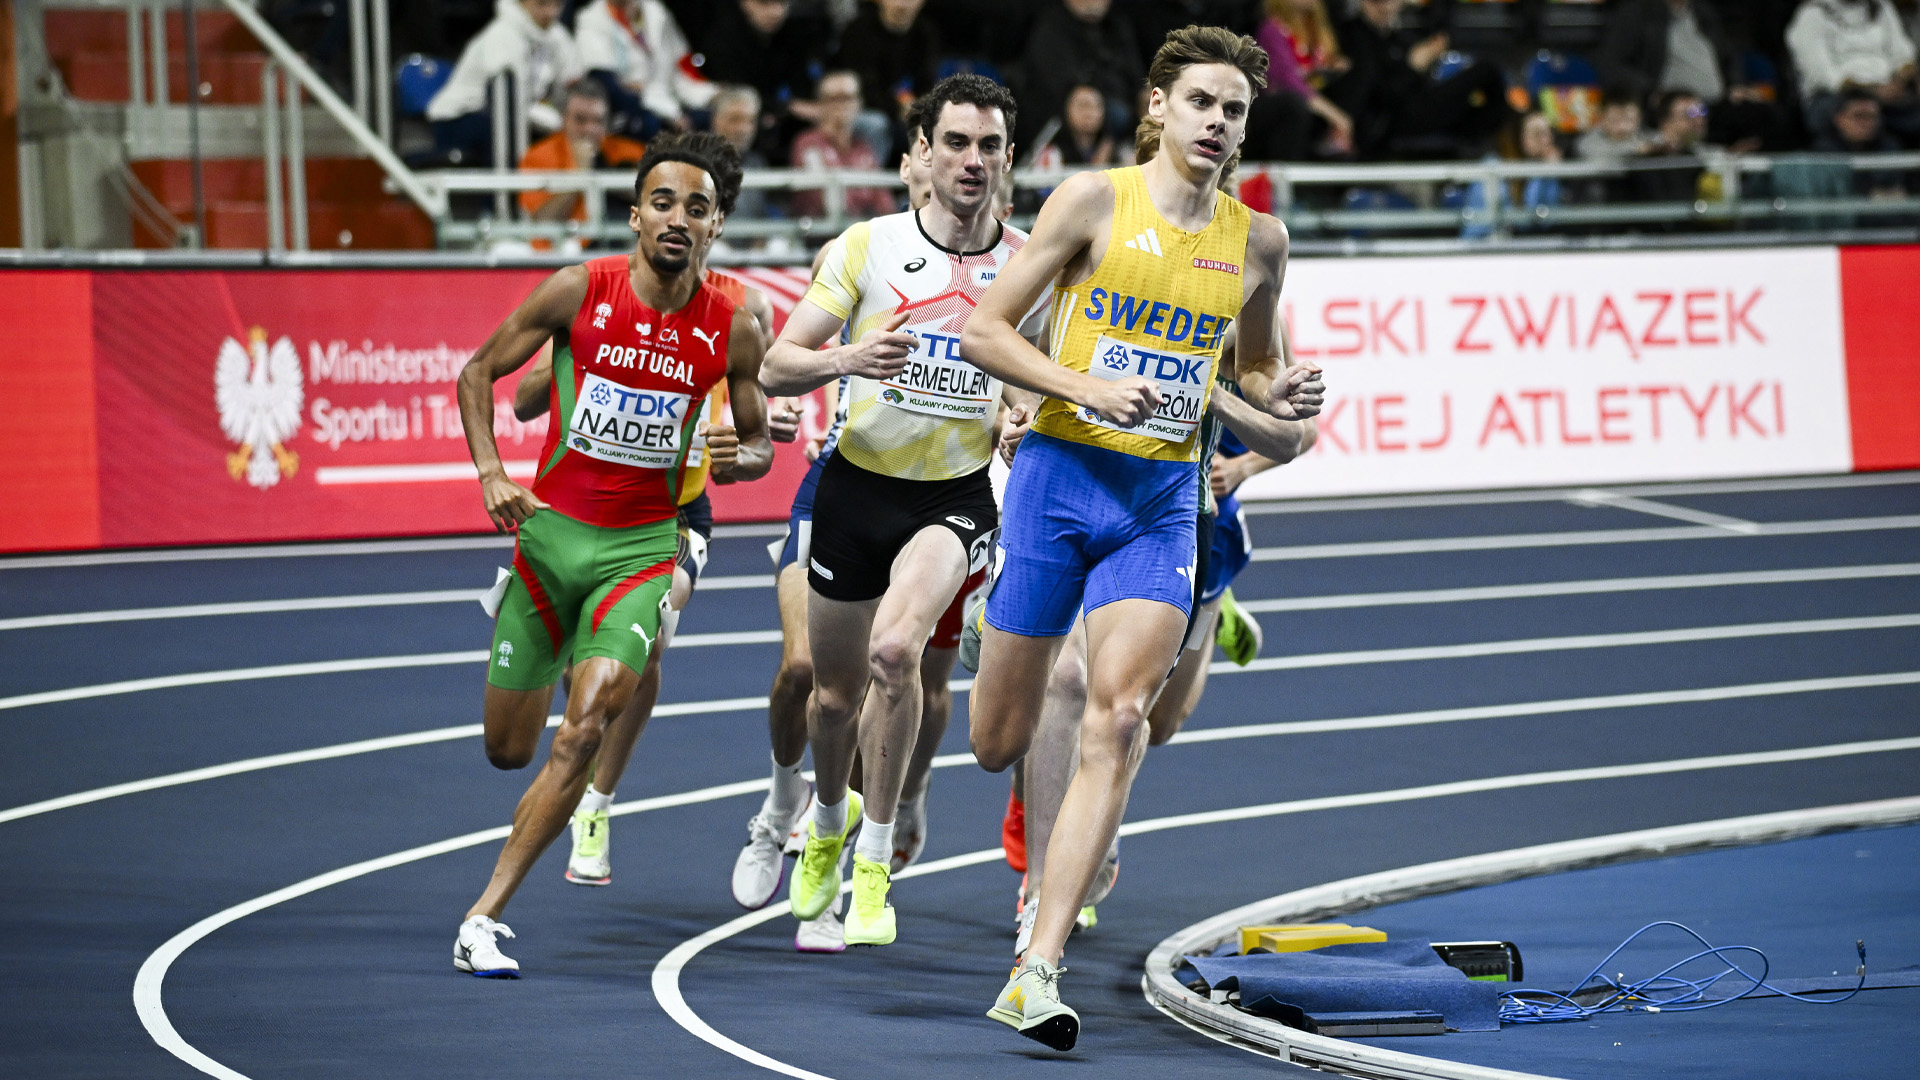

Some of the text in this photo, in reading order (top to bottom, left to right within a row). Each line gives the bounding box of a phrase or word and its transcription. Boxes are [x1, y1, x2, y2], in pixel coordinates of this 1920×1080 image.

[1194, 258, 1239, 275] BAUHAUS
[659, 327, 680, 345] CA
[1085, 287, 1233, 350] SWEDEN
[1285, 287, 1767, 361] LSKI ZWIĄZEK
[921, 332, 962, 361] TD
[595, 343, 695, 387] PORTUGAL
[893, 361, 990, 397] ERMEULEN
[1131, 348, 1206, 385] TDK
[613, 387, 681, 419] TDK
[909, 397, 941, 409] KUJAWY
[942, 402, 977, 414] POMORZE
[1315, 380, 1787, 455] KIEJ ATLETYKI
[311, 396, 407, 450] Sportu
[413, 394, 422, 437] i
[578, 407, 675, 448] NADER
[1147, 423, 1185, 437] POMORZE
[597, 447, 628, 460] KUJAWY
[628, 452, 663, 464] POMORZE
